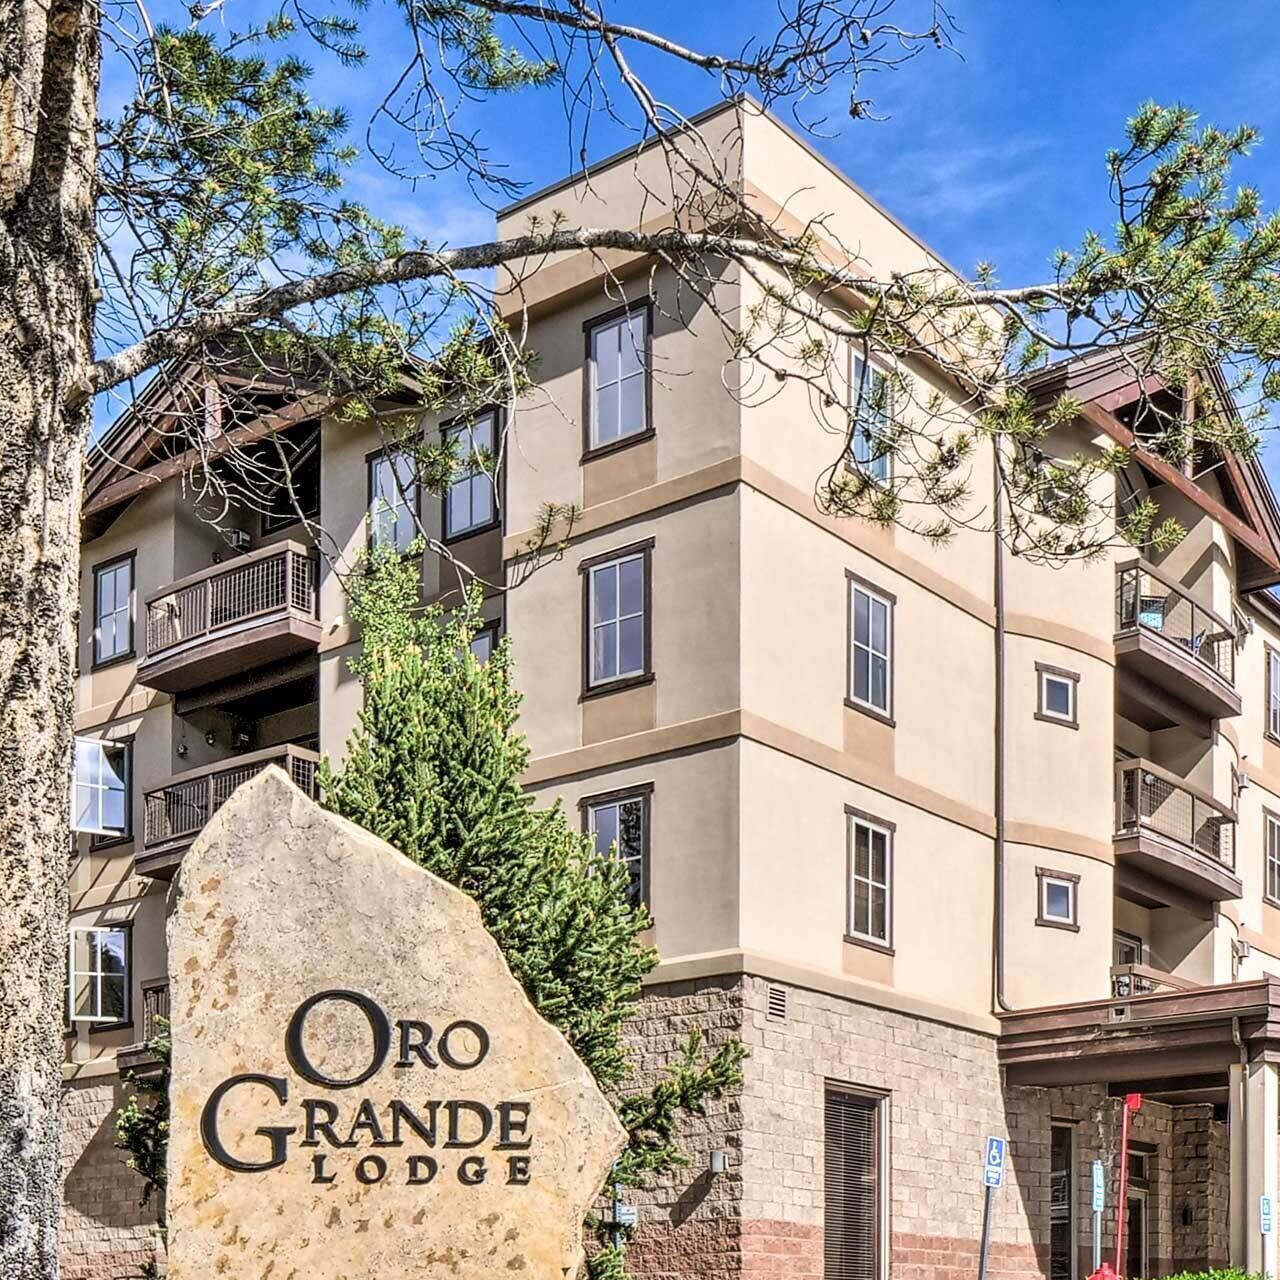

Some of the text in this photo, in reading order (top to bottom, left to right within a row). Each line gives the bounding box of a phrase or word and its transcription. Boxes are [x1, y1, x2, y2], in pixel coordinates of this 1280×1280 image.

[285, 989, 490, 1089] ORO
[201, 1073, 532, 1173] GRANDE
[312, 1155, 531, 1185] LODGE
